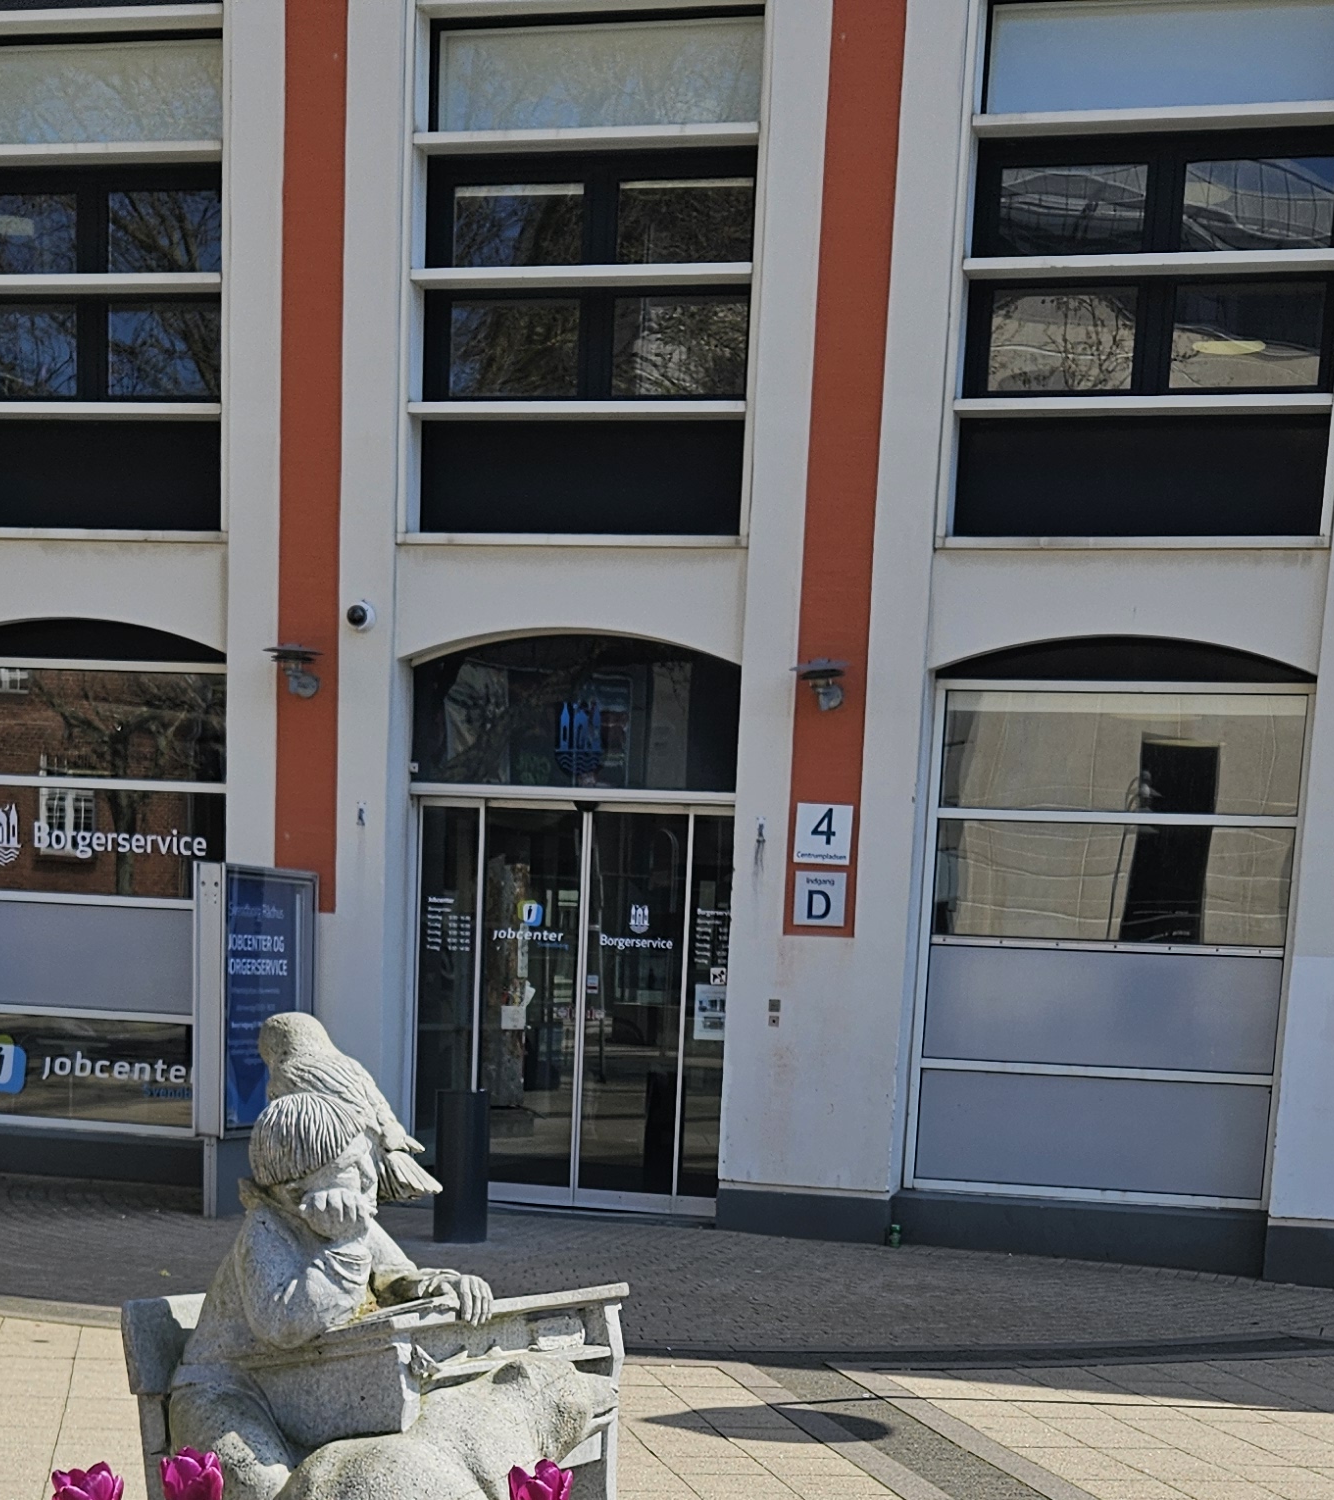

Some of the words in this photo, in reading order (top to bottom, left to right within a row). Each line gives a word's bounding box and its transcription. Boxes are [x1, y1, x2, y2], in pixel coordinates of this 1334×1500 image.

[811, 808, 837, 846] 4
[34, 821, 207, 859] Borgerservice
[796, 851, 847, 861] Centrumpladsen
[806, 877, 835, 887] Indgang
[262, 902, 284, 919] Rådhus
[697, 907, 731, 917] Borgerservi
[807, 890, 832, 920] D
[493, 927, 564, 942] jobcenter
[600, 933, 674, 950] Borgerservice
[273, 937, 284, 952] OG
[228, 958, 288, 976] ORGERSERVICE
[142, 1083, 193, 1099] Svendb
